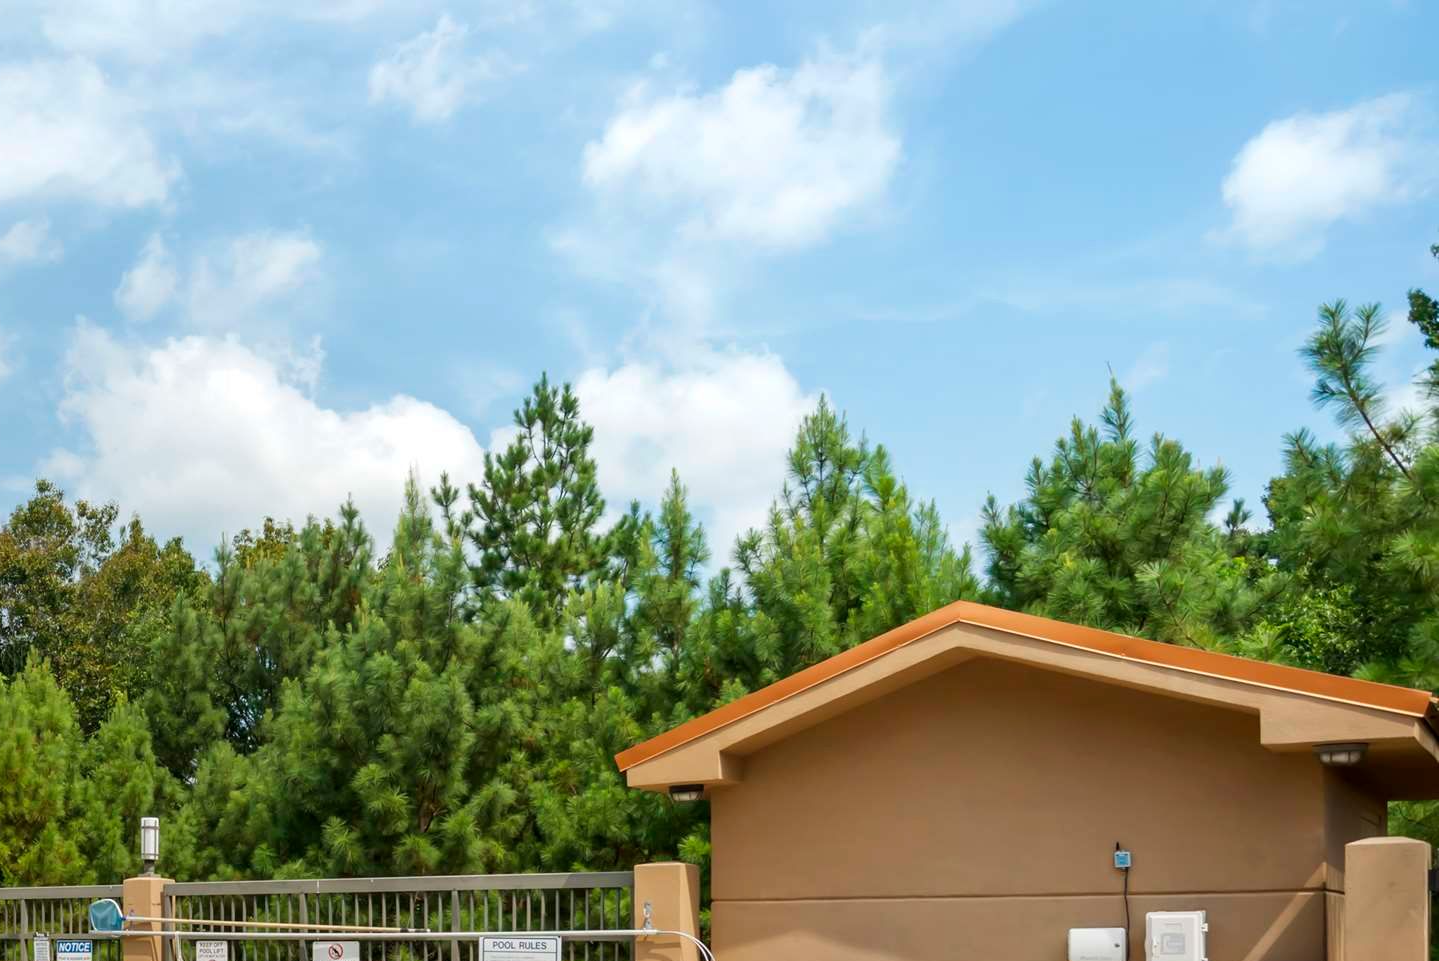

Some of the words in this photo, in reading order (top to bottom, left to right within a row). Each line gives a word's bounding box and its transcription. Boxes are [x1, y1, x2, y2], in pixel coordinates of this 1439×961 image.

[59, 942, 90, 952] NOTICE
[492, 941, 516, 950] POOL
[519, 941, 547, 950] RULES
